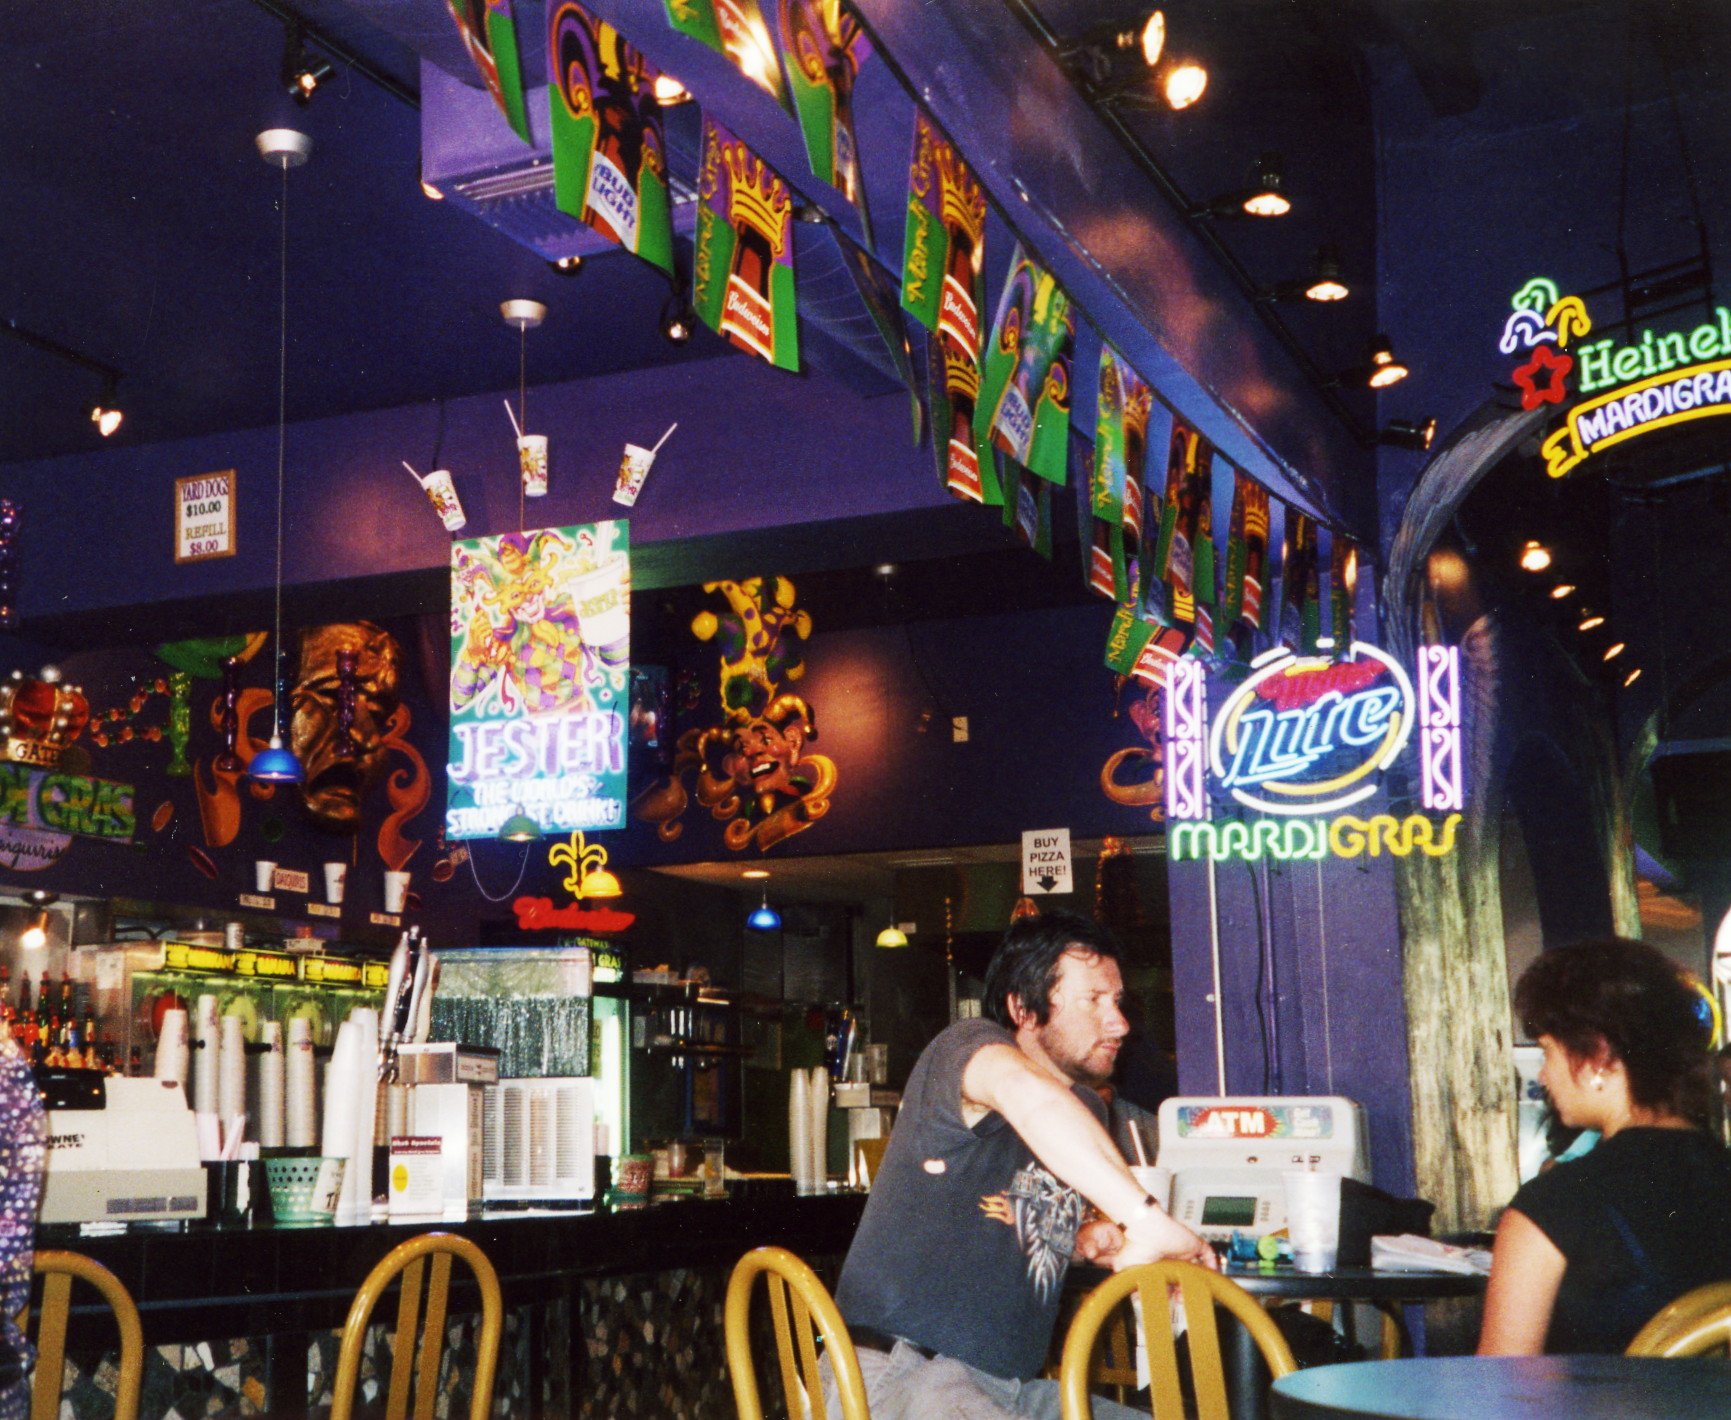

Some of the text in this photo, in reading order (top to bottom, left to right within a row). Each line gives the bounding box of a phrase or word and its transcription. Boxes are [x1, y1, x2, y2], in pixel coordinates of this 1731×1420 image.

[594, 163, 634, 208] BUD
[592, 176, 636, 229] LIGHT
[727, 290, 771, 337] Budweiser
[186, 500, 221, 517] $10.00
[185, 522, 226, 540] REFILL
[190, 540, 219, 555] $8.00
[446, 711, 624, 783] JESTER
[471, 780, 508, 805] THE
[1034, 836, 1058, 848] BUY
[1030, 851, 1064, 863] PIZZA
[1029, 864, 1066, 877] HERE!
[1207, 1110, 1265, 1134] ATM
